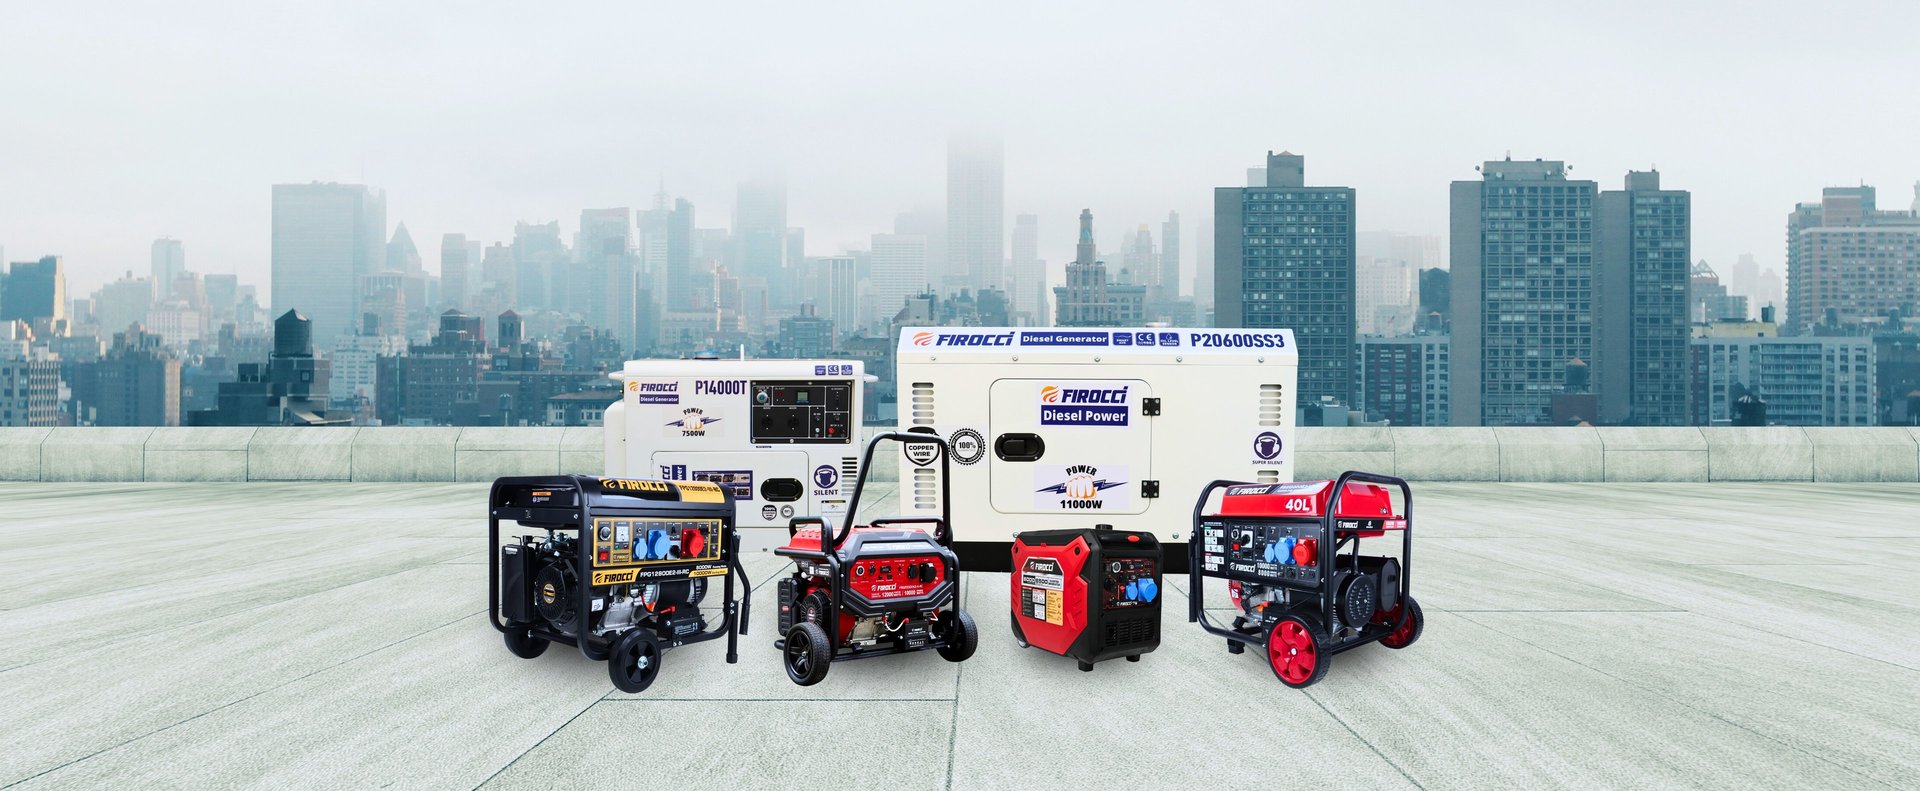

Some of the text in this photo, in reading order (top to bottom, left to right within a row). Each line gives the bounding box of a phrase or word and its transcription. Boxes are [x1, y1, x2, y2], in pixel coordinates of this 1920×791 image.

[1022, 335, 1107, 343] Diesel Generator
[1191, 333, 1285, 348] P20600SS3
[695, 380, 747, 395] P14000T
[682, 407, 704, 416] POWER
[1043, 409, 1126, 422] Diesel Power
[958, 441, 976, 449] 100%
[1065, 464, 1098, 476] POWER
[1060, 499, 1103, 509] 11000W
[1285, 498, 1310, 512] 40L
